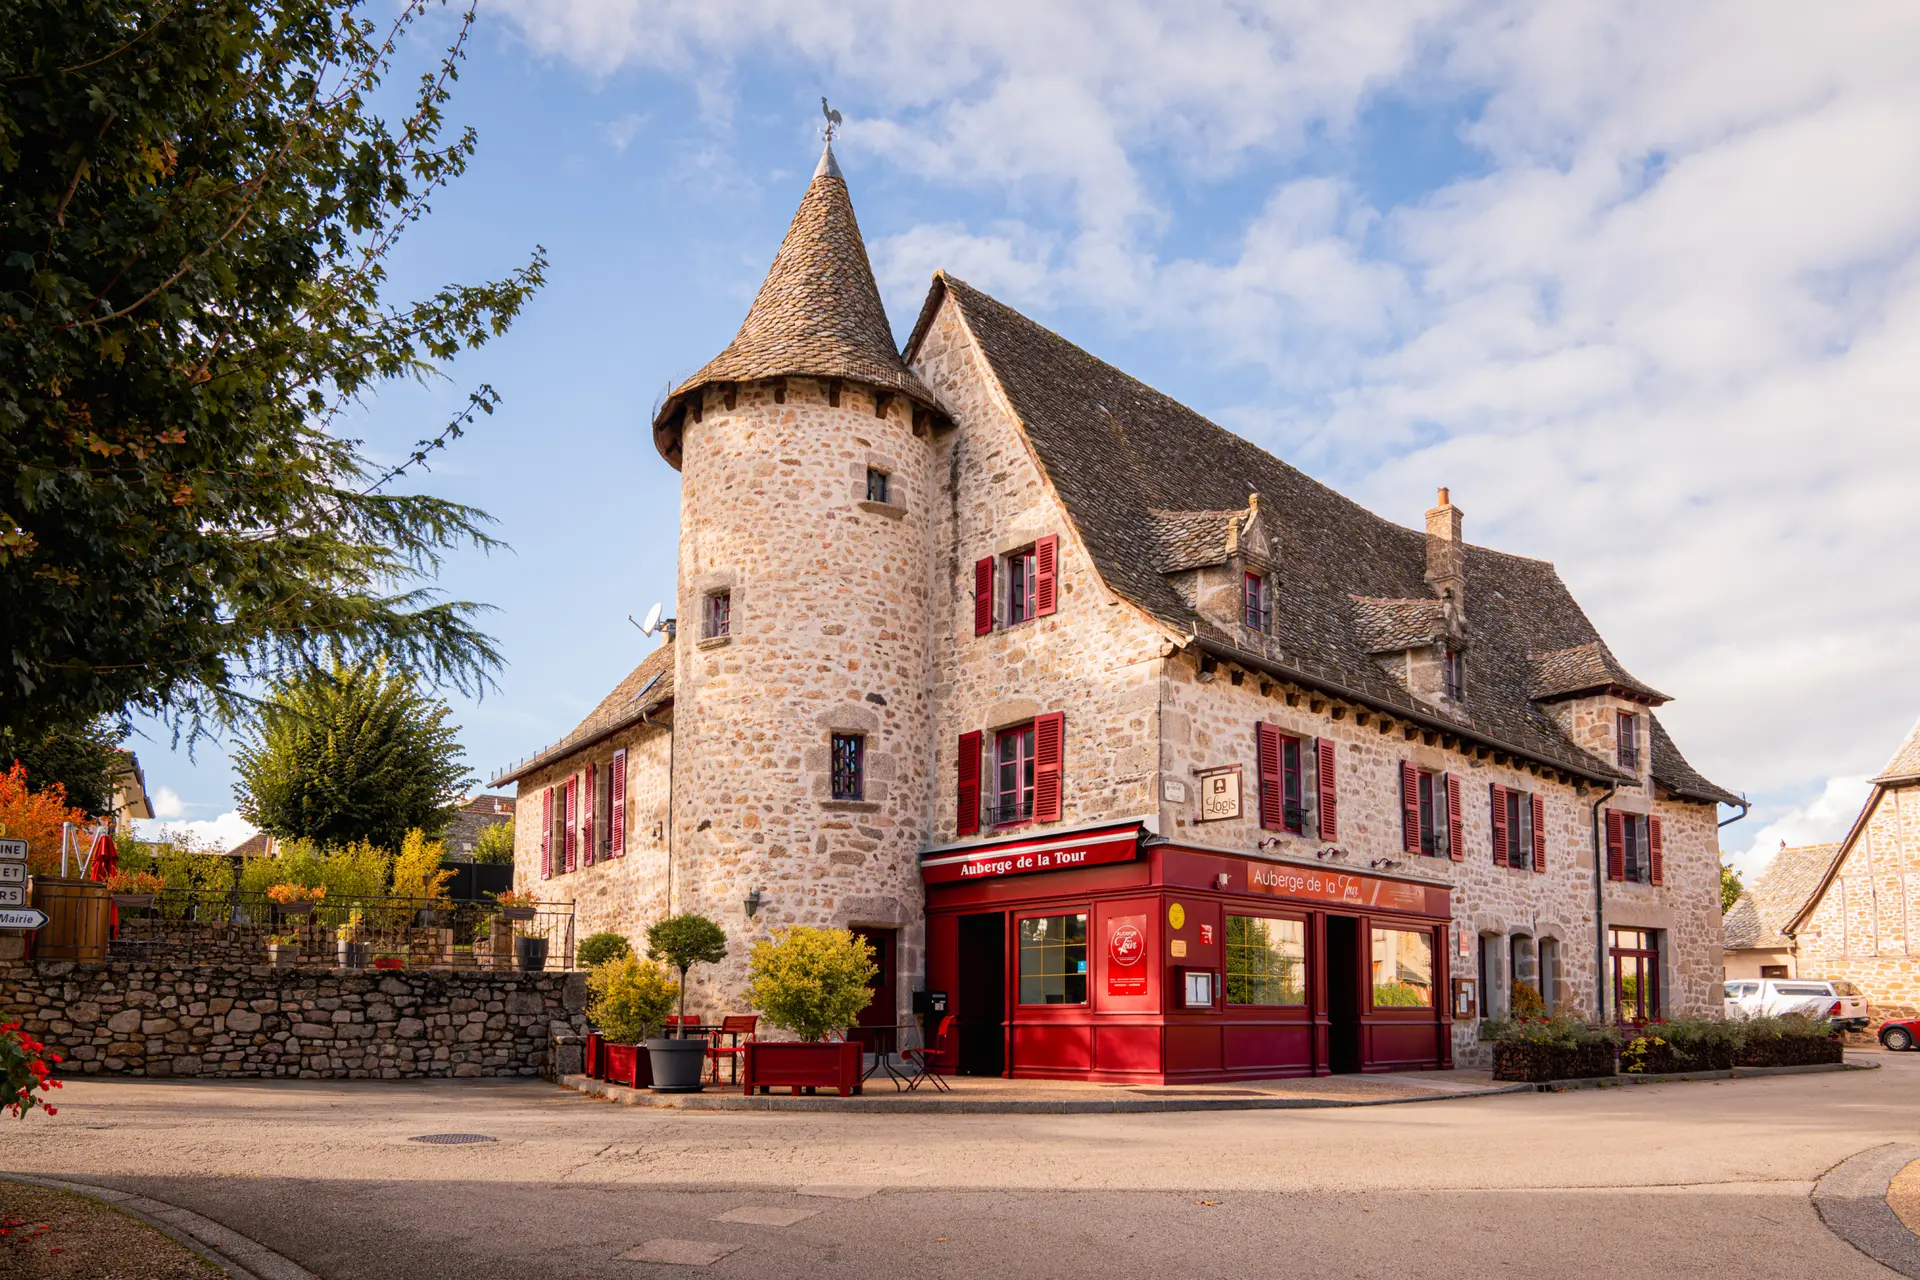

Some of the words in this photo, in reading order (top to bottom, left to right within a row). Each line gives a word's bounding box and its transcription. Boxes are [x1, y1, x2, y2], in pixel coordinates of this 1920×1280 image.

[1205, 795, 1236, 815] Logis
[960, 860, 1012, 875] Auberge
[1016, 856, 1033, 868] de
[1037, 854, 1050, 866] la
[1054, 851, 1087, 864] Tour
[1253, 869, 1304, 892] Auberge
[1307, 876, 1321, 892] de
[1325, 878, 1336, 894] la
[1338, 875, 1359, 901] Tour
[0, 891, 18, 901] RS
[0, 913, 34, 924] Mairie
